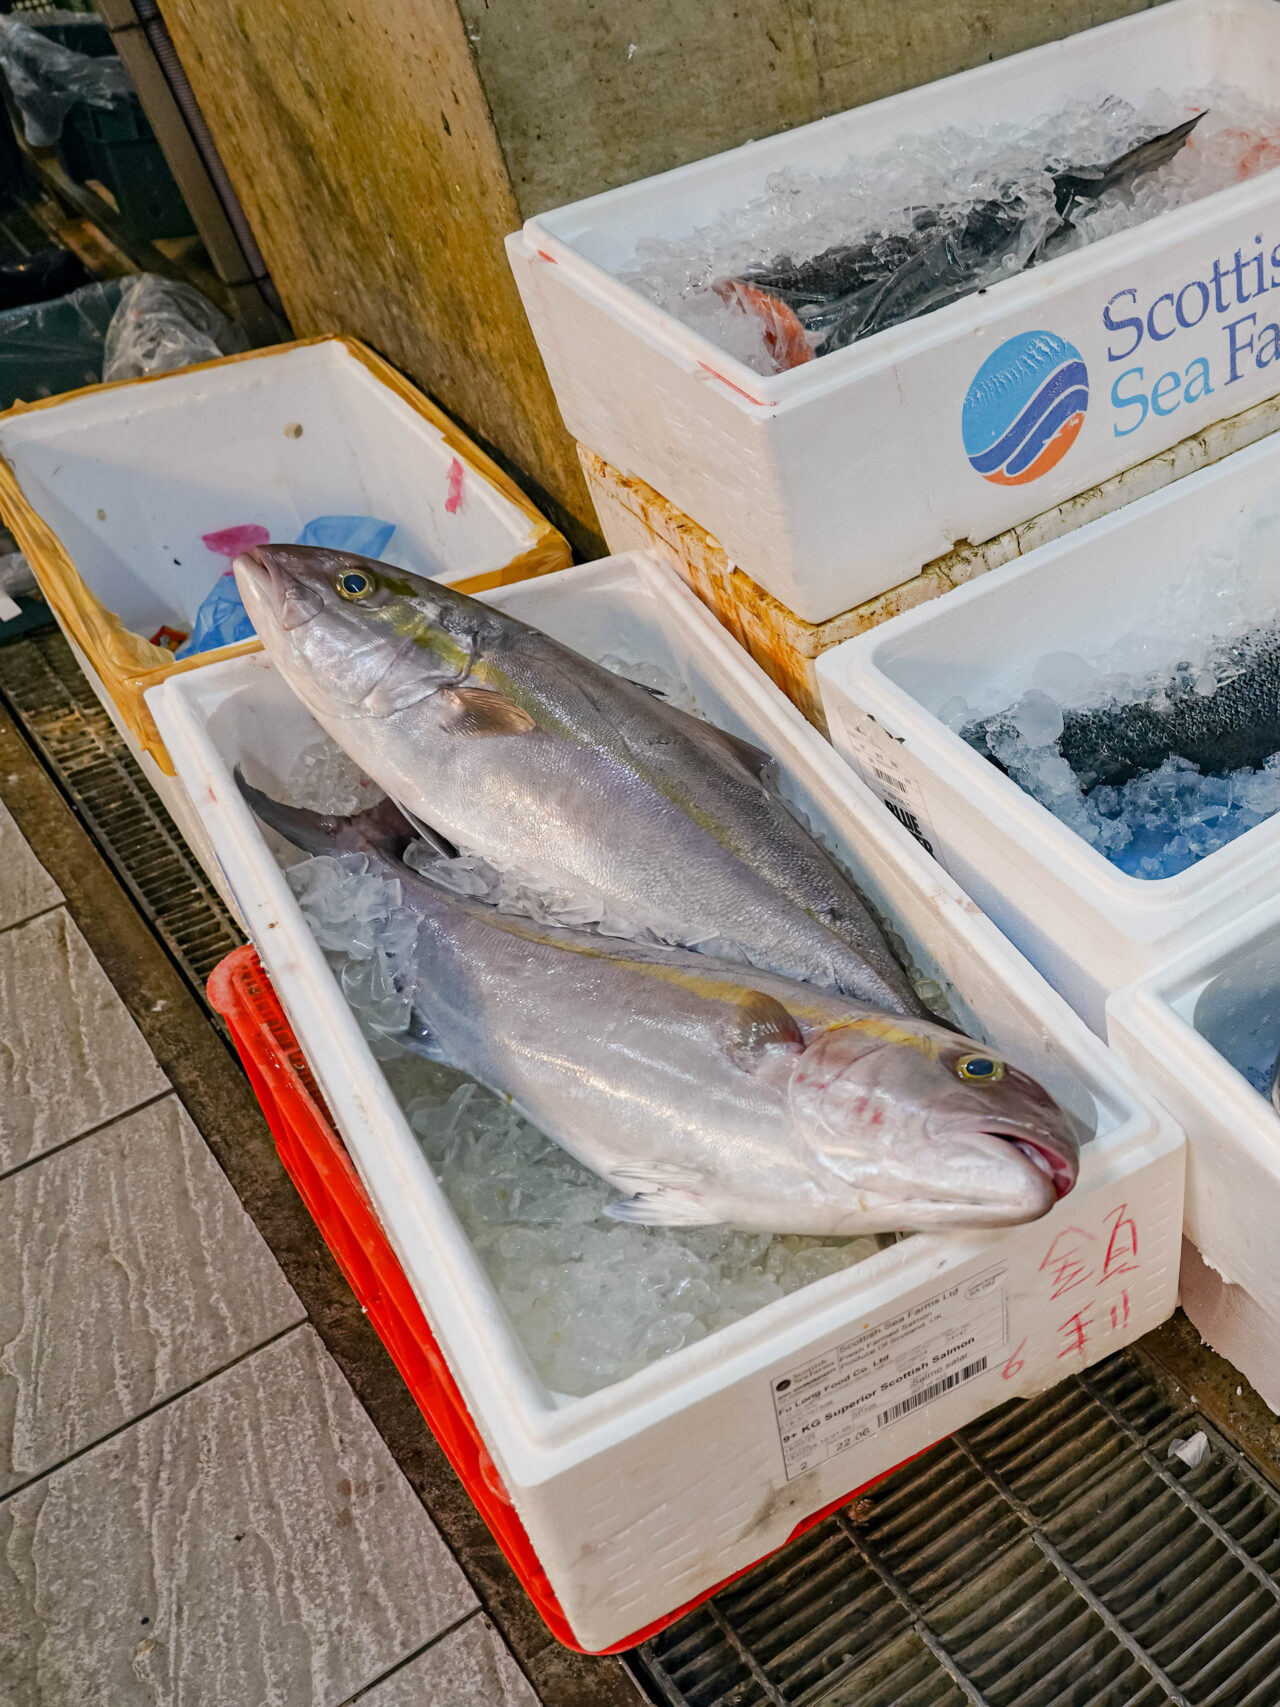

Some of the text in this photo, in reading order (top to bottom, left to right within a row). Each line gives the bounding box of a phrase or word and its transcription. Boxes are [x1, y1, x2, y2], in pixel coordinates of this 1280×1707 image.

[1110, 357, 1215, 437] Sea
[840, 1287, 959, 1353] Scottish Sea Farms Ltd
[778, 1406, 792, 1416] Fu
[794, 1390, 821, 1408] Long
[824, 1374, 851, 1392] Food
[872, 1353, 890, 1367] Ltd
[782, 1432, 797, 1444] 9+
[801, 1418, 821, 1434] KG
[824, 1388, 878, 1421] Superior
[880, 1361, 929, 1392] Scottish
[931, 1336, 975, 1364] Salmon
[912, 1365, 943, 1386] Salmo
[945, 1352, 968, 1370] salar
